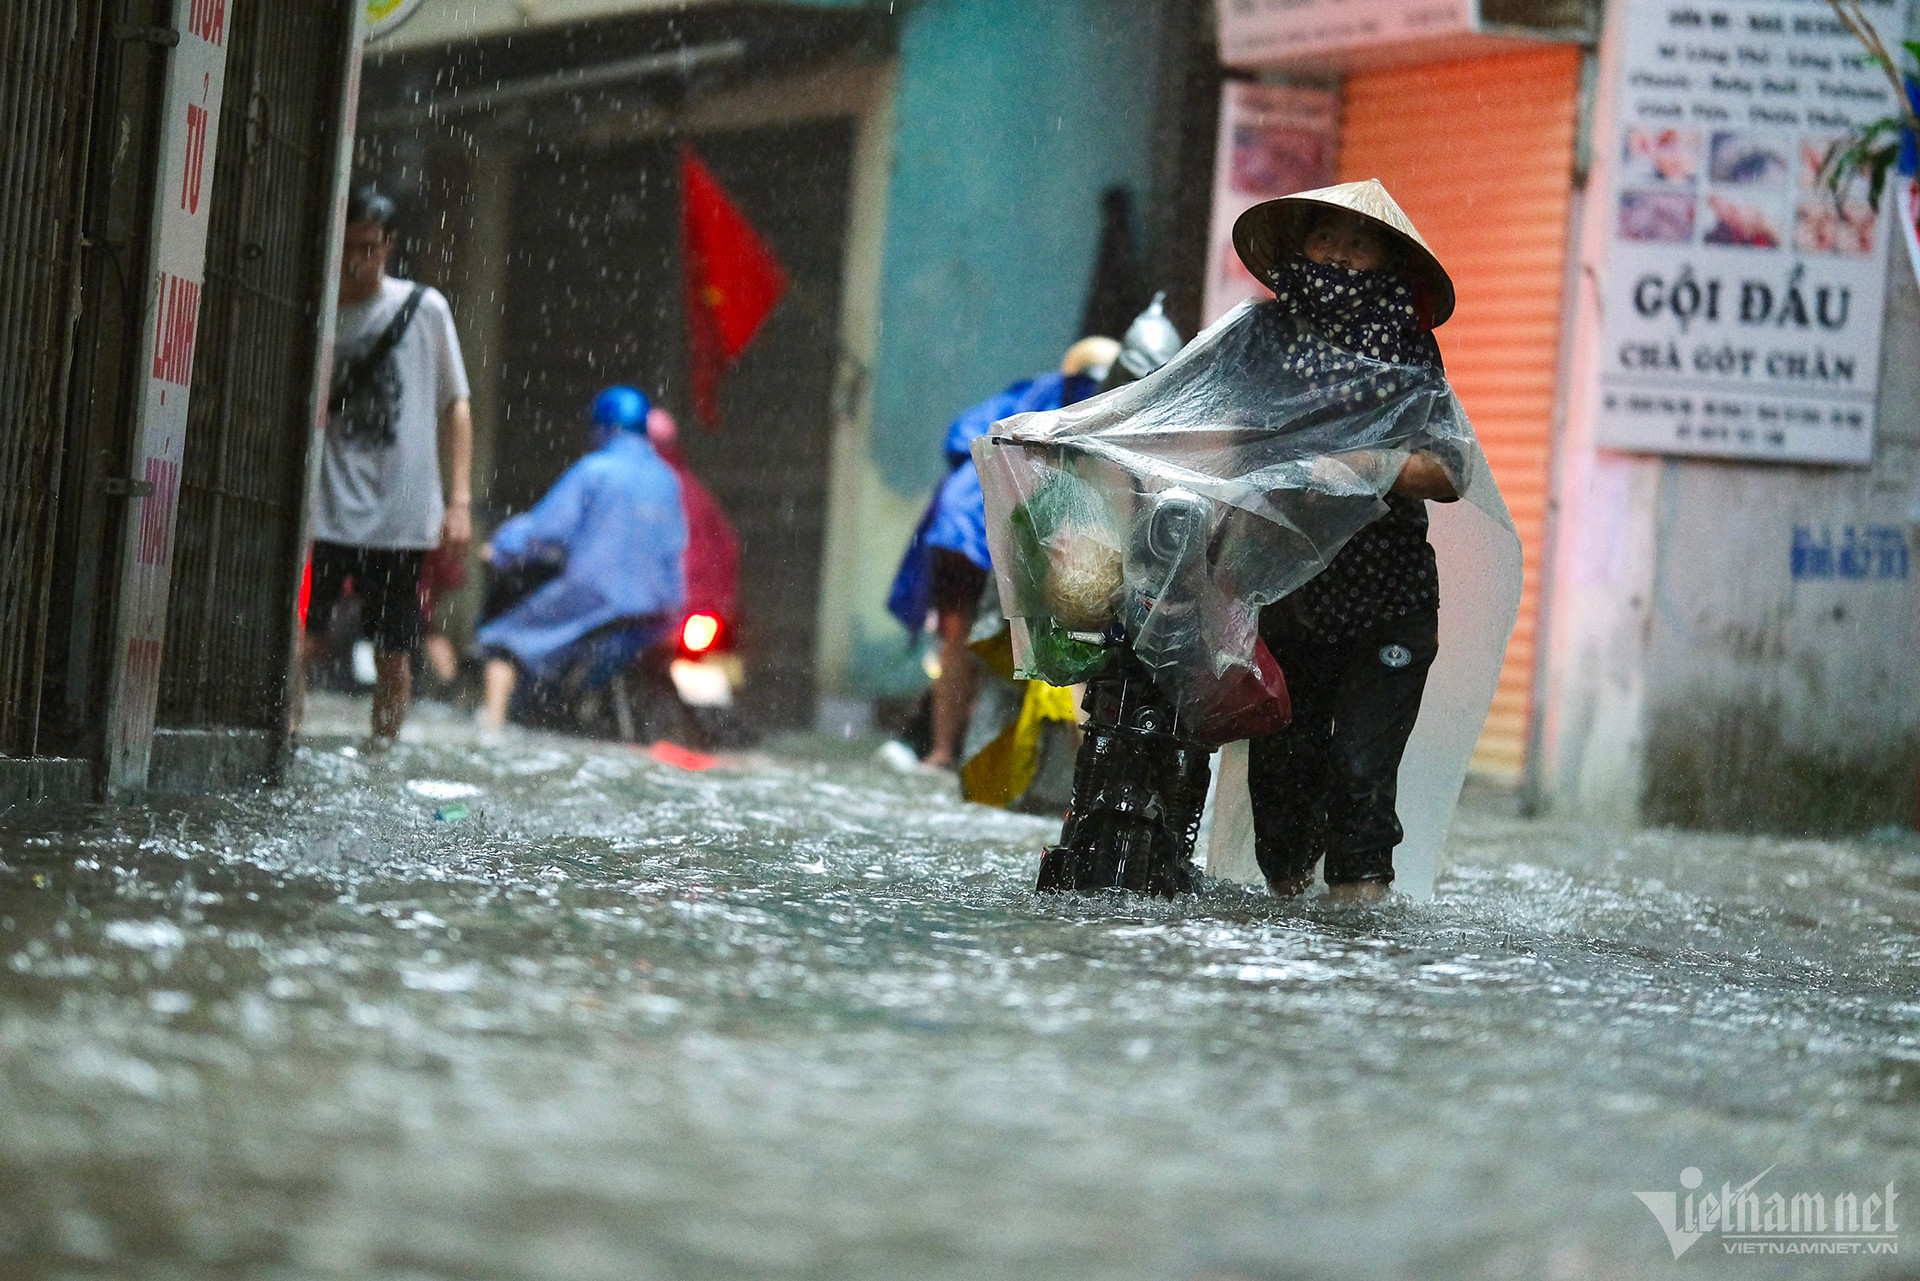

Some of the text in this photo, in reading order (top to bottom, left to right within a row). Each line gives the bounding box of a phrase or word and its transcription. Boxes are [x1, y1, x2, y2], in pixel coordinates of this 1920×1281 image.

[181, 71, 210, 216] TỦ
[152, 271, 199, 405] LẠNH
[1634, 263, 1720, 335] GỘI
